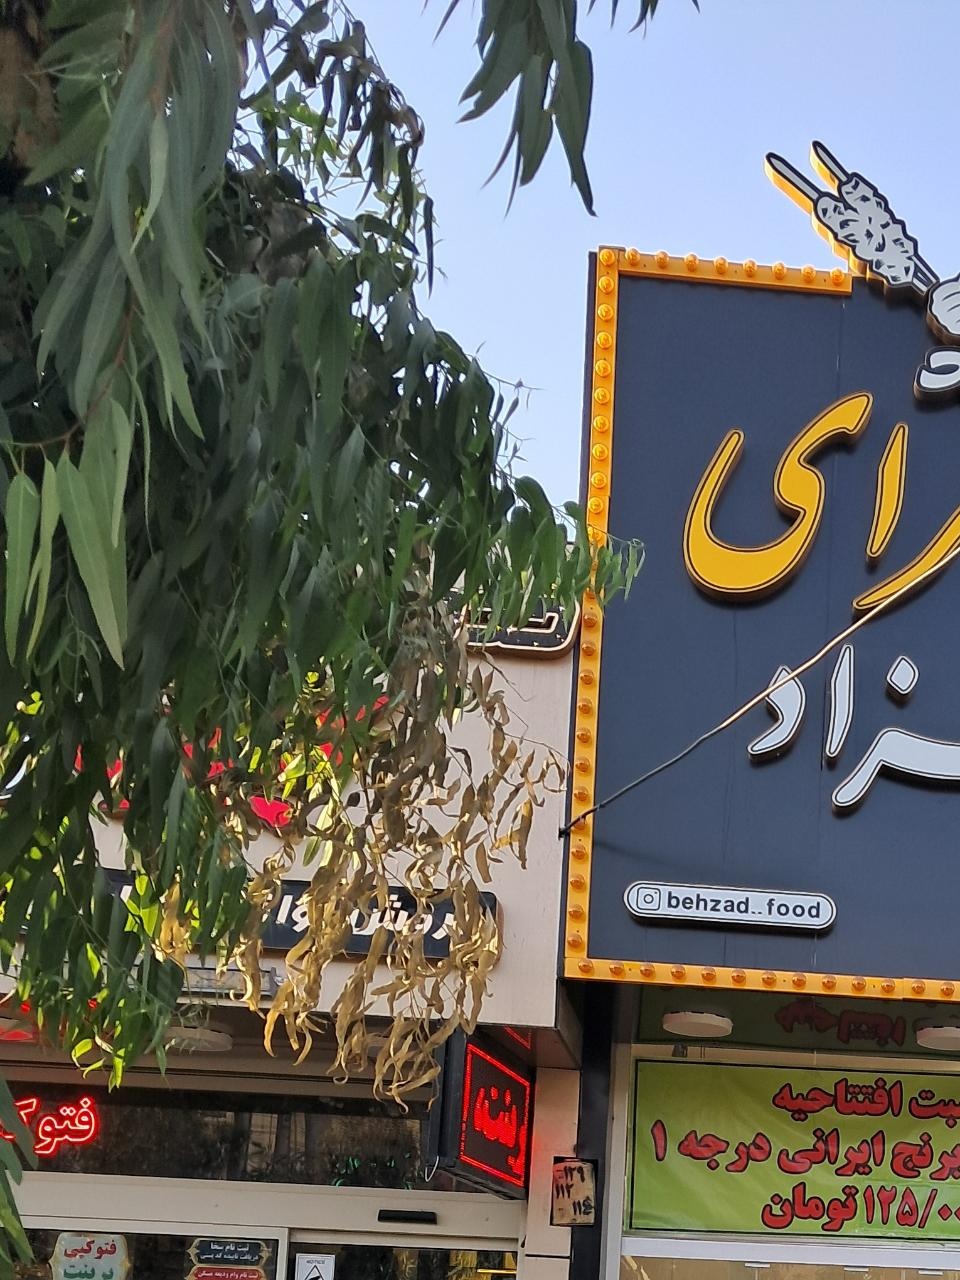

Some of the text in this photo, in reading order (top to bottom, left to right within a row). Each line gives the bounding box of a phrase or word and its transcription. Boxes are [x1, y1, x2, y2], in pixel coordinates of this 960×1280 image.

[772, 1077, 903, 1122] افتتاحیه
[678, 1129, 772, 1173] درجه
[777, 1128, 885, 1177] ایرانی
[761, 1181, 859, 1232] تومان
[63, 1239, 117, 1260] فتوکپی
